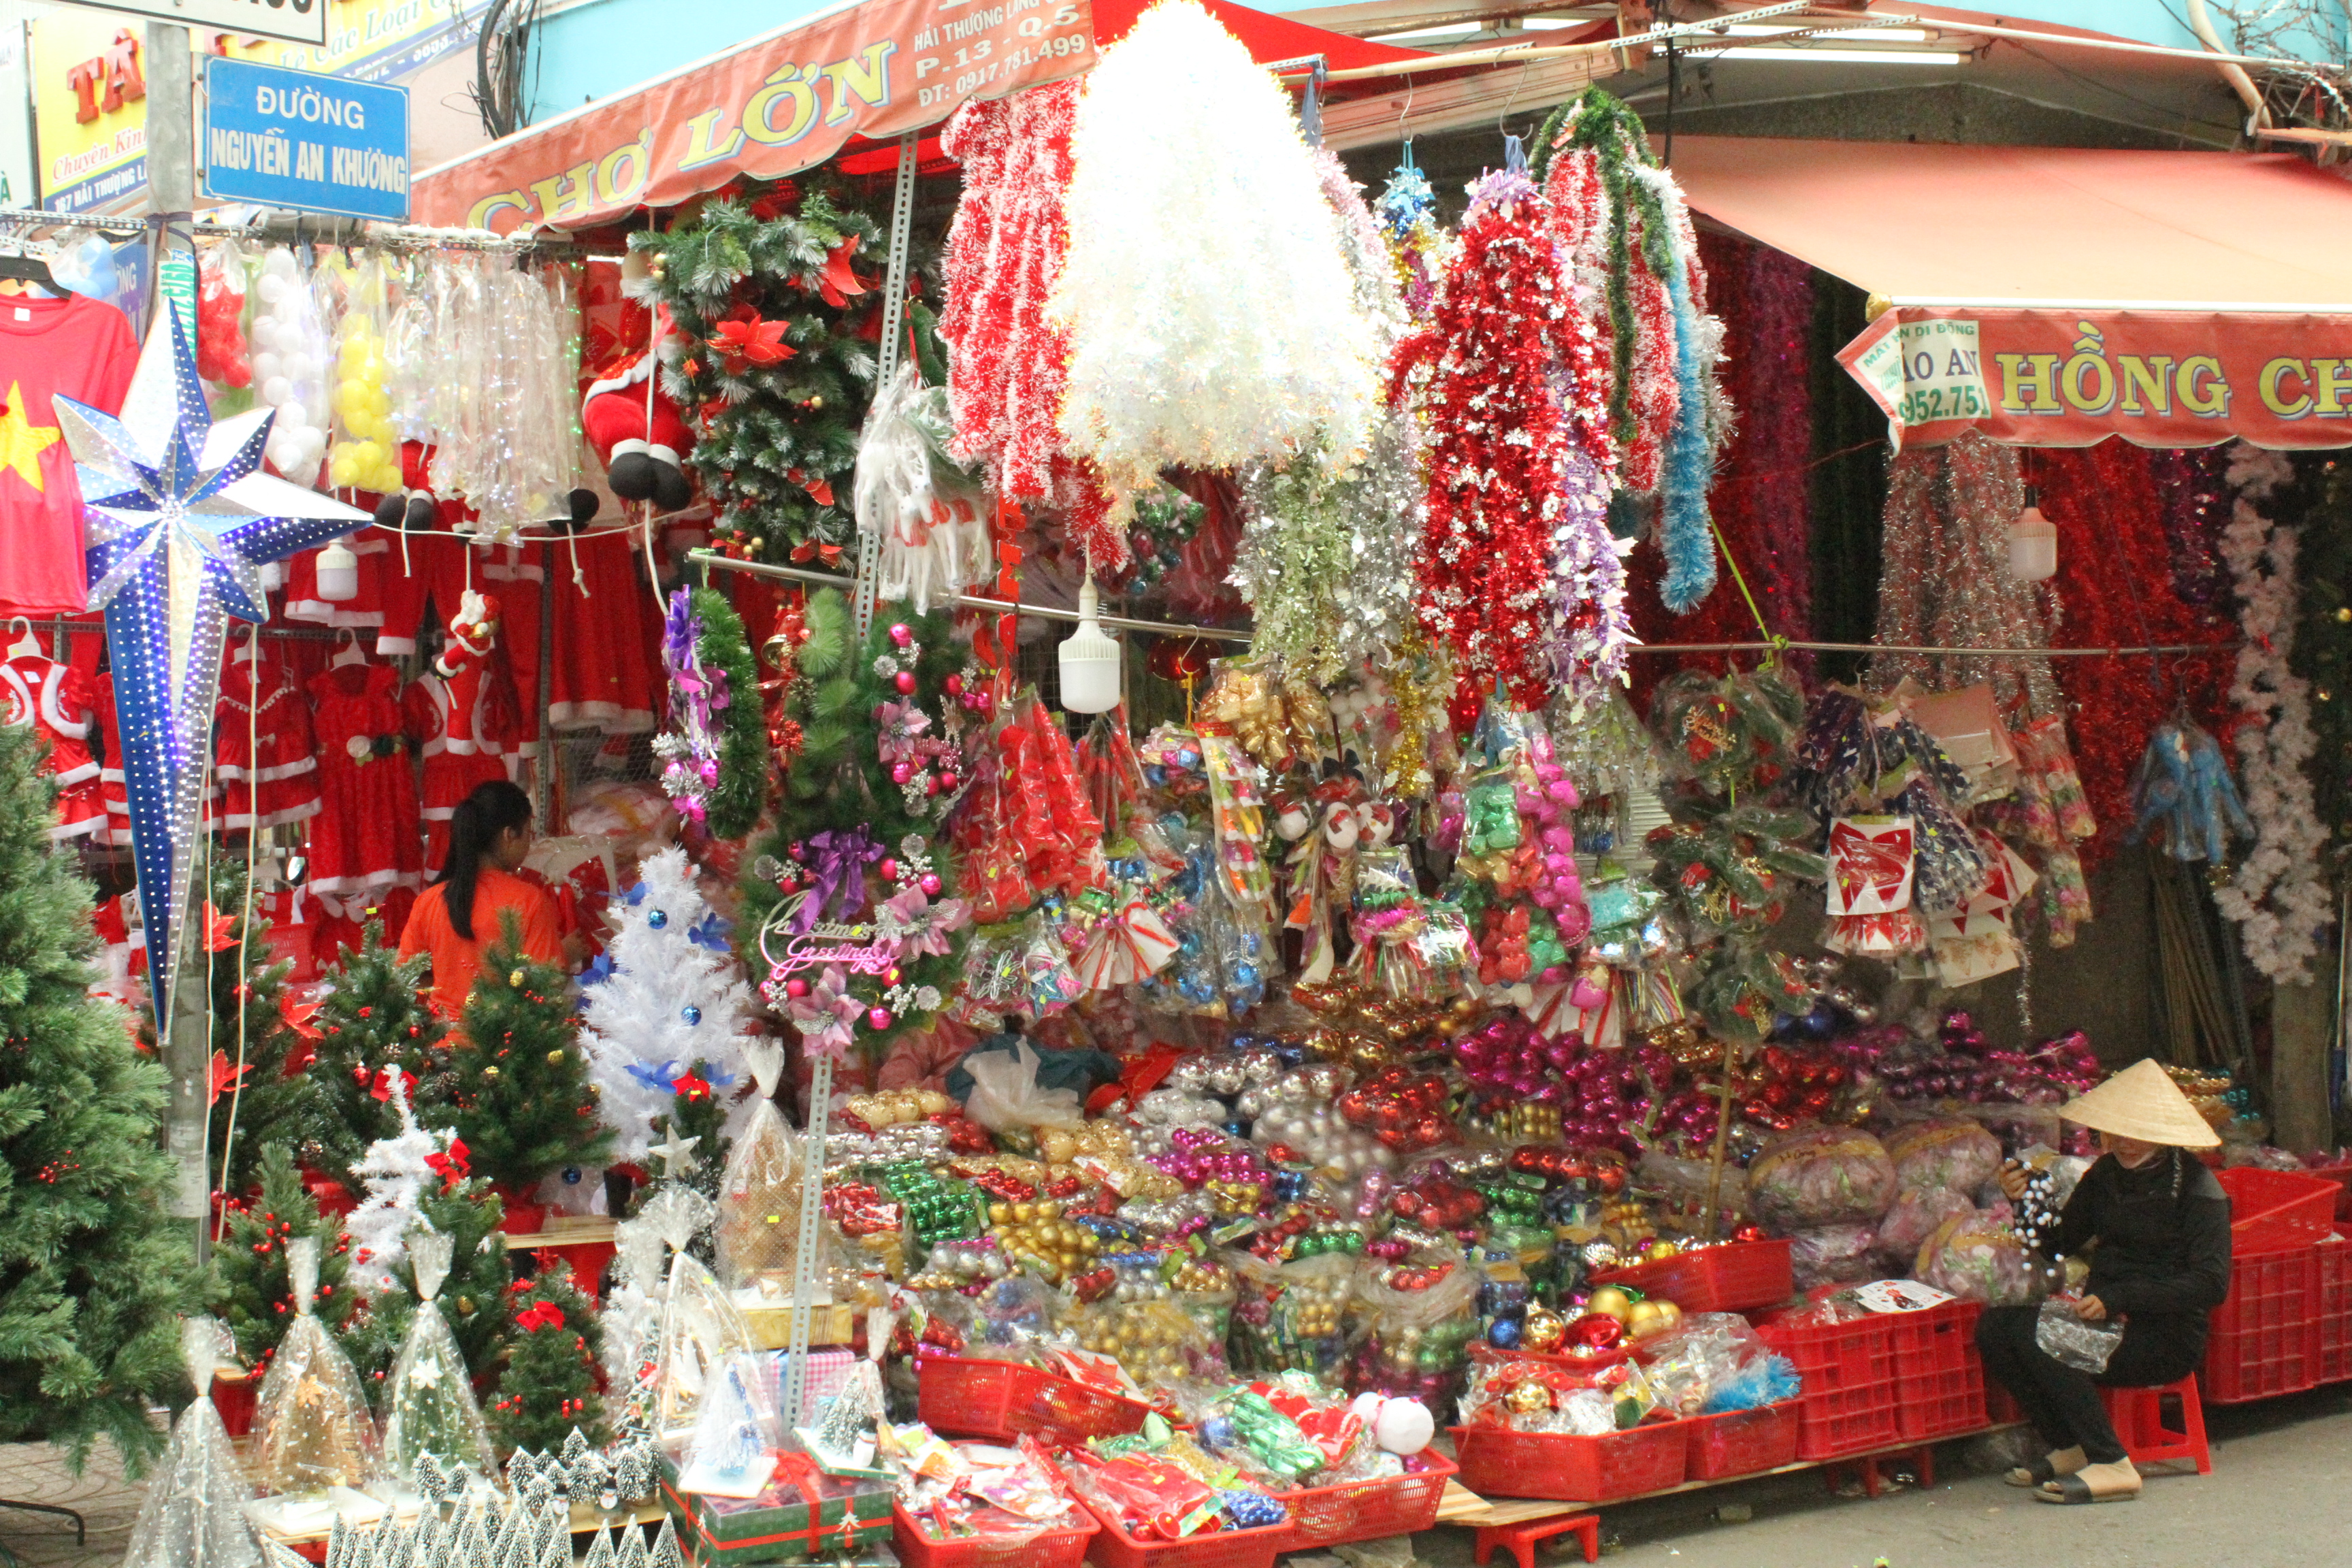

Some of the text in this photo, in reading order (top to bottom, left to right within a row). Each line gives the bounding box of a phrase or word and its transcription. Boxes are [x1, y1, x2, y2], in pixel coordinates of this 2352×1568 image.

[914, 24, 940, 52] HẢI
[943, 6, 1003, 40] THƯỢNG
[918, 33, 1086, 108] ĐT: 0917.781.499
[256, 85, 365, 129] ĐƯỜNG
[676, 37, 898, 172] LỚN
[211, 127, 406, 195] NGUYỄN AN KHƯƠNG
[1915, 325, 1931, 337] DI
[1937, 322, 1974, 336] ĐỘNG
[1946, 348, 1980, 376] AN
[1995, 320, 2232, 419] HỒNG
